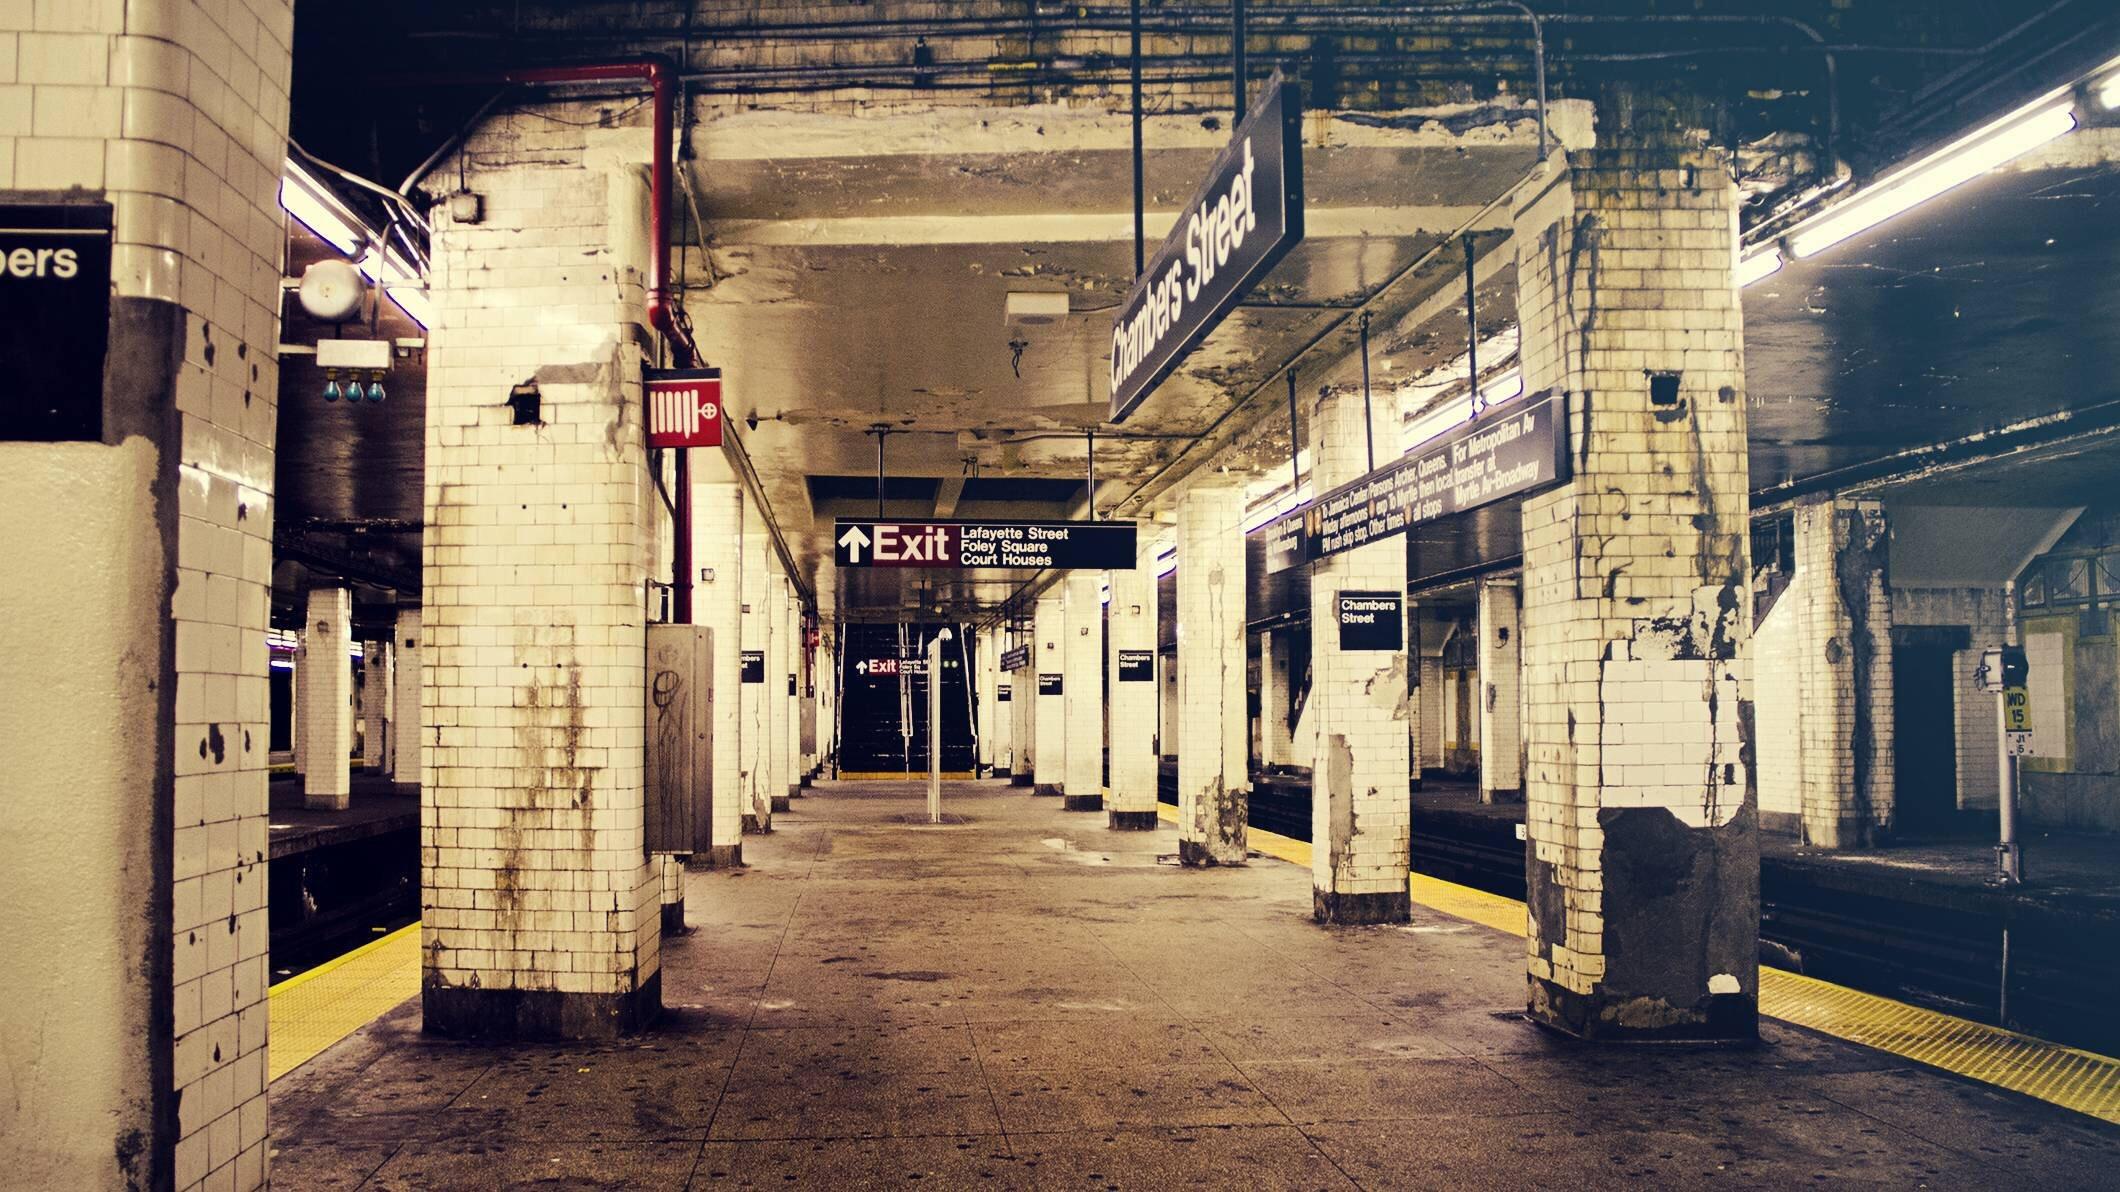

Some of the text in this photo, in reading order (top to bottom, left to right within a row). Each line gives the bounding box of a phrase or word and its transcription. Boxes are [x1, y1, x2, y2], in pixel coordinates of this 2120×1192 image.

[0, 247, 78, 278] ers
[1111, 136, 1256, 394] Chambers Street
[1453, 412, 1534, 463] For Metropolitan Av
[1455, 449, 1496, 485] transfer at
[1339, 508, 1367, 529] afternoons
[1396, 486, 1417, 511] Myrtle
[1419, 478, 1434, 498] then
[1455, 481, 1479, 506] Myrtle
[1329, 496, 1348, 516] Jamaica
[961, 526, 1069, 541] Lafayette Street
[1331, 535, 1341, 549] rush
[1343, 529, 1353, 547] skip
[1368, 519, 1385, 536] Other
[1386, 513, 1403, 530] times
[1423, 499, 1442, 518] stops
[873, 525, 949, 561] Exit
[961, 540, 1048, 555] Foley Square
[961, 553, 1052, 566] Court Houses
[1341, 600, 1396, 610] Chambers
[1341, 613, 1375, 624] Street
[868, 659, 896, 672] Exit
[2008, 692, 2026, 706] WD
[2012, 709, 2024, 723] 15
